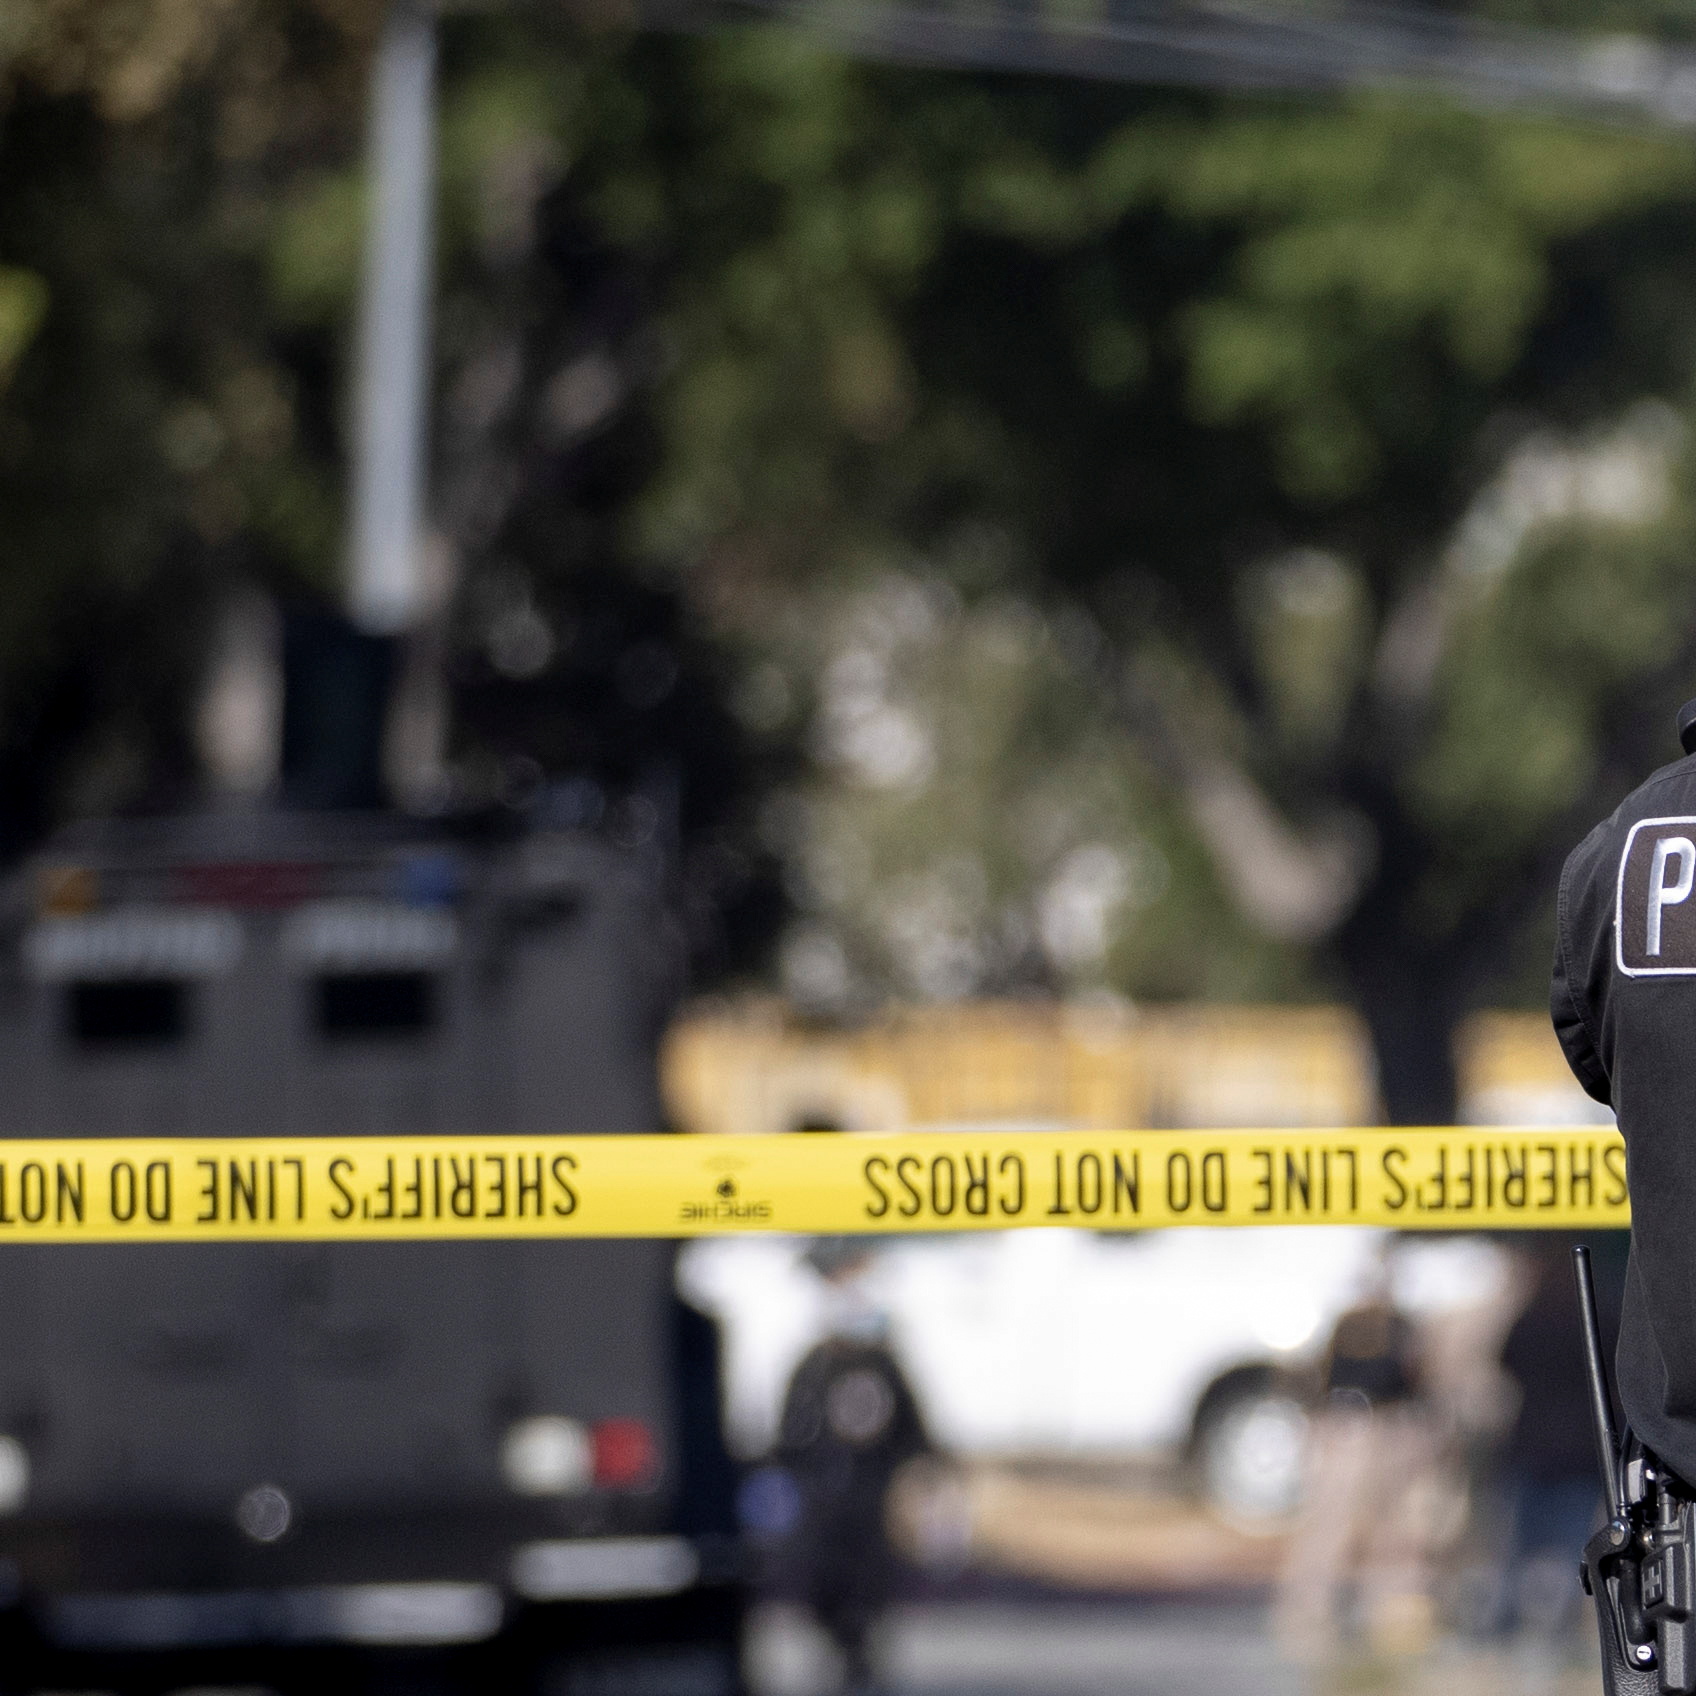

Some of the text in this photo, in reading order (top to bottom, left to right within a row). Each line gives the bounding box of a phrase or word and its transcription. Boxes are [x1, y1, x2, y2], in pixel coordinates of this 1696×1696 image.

[0, 1155, 579, 1226] SHERIFF'S LINE DO NOT
[864, 1145, 1627, 1219] SHERIFF'S LINE DO NOT CROSS
